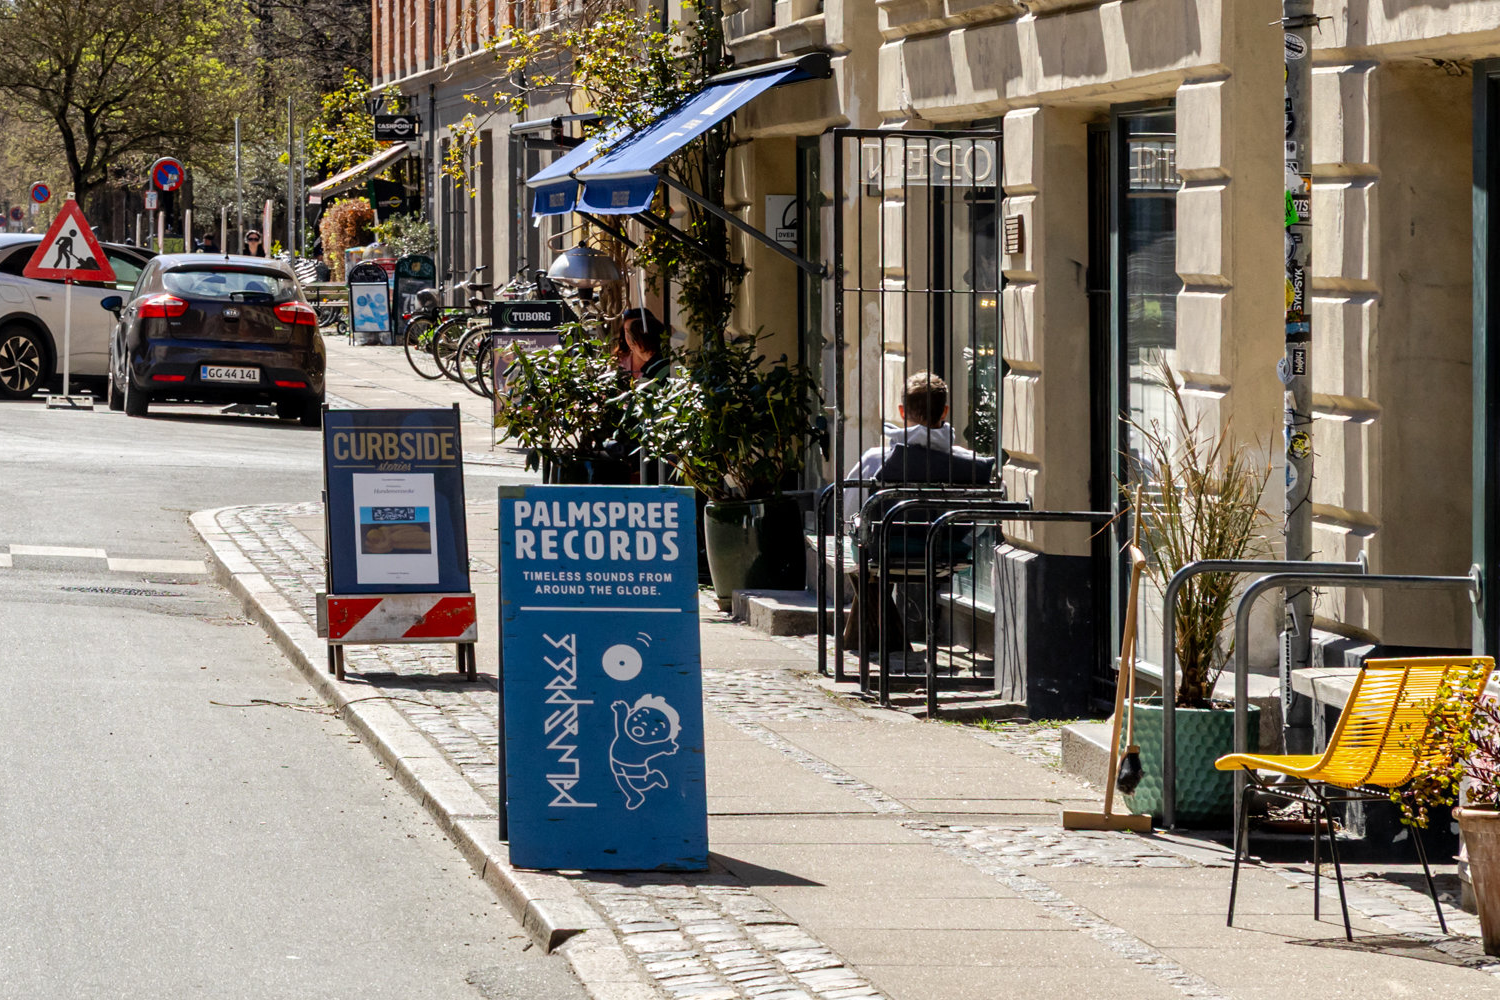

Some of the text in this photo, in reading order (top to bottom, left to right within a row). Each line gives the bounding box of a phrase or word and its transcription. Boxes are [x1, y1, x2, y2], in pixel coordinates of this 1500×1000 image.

[512, 312, 551, 322] TUBORG
[208, 369, 256, 379] GG 44 141
[333, 432, 456, 460] CURBSIDE
[377, 462, 411, 471] stories
[514, 501, 679, 528] PALMSPREE
[515, 529, 679, 561] RECORDS
[523, 571, 672, 582] TIMELESS SOUNDS FROM
[535, 585, 661, 595] AROUND THE GLOBE.
